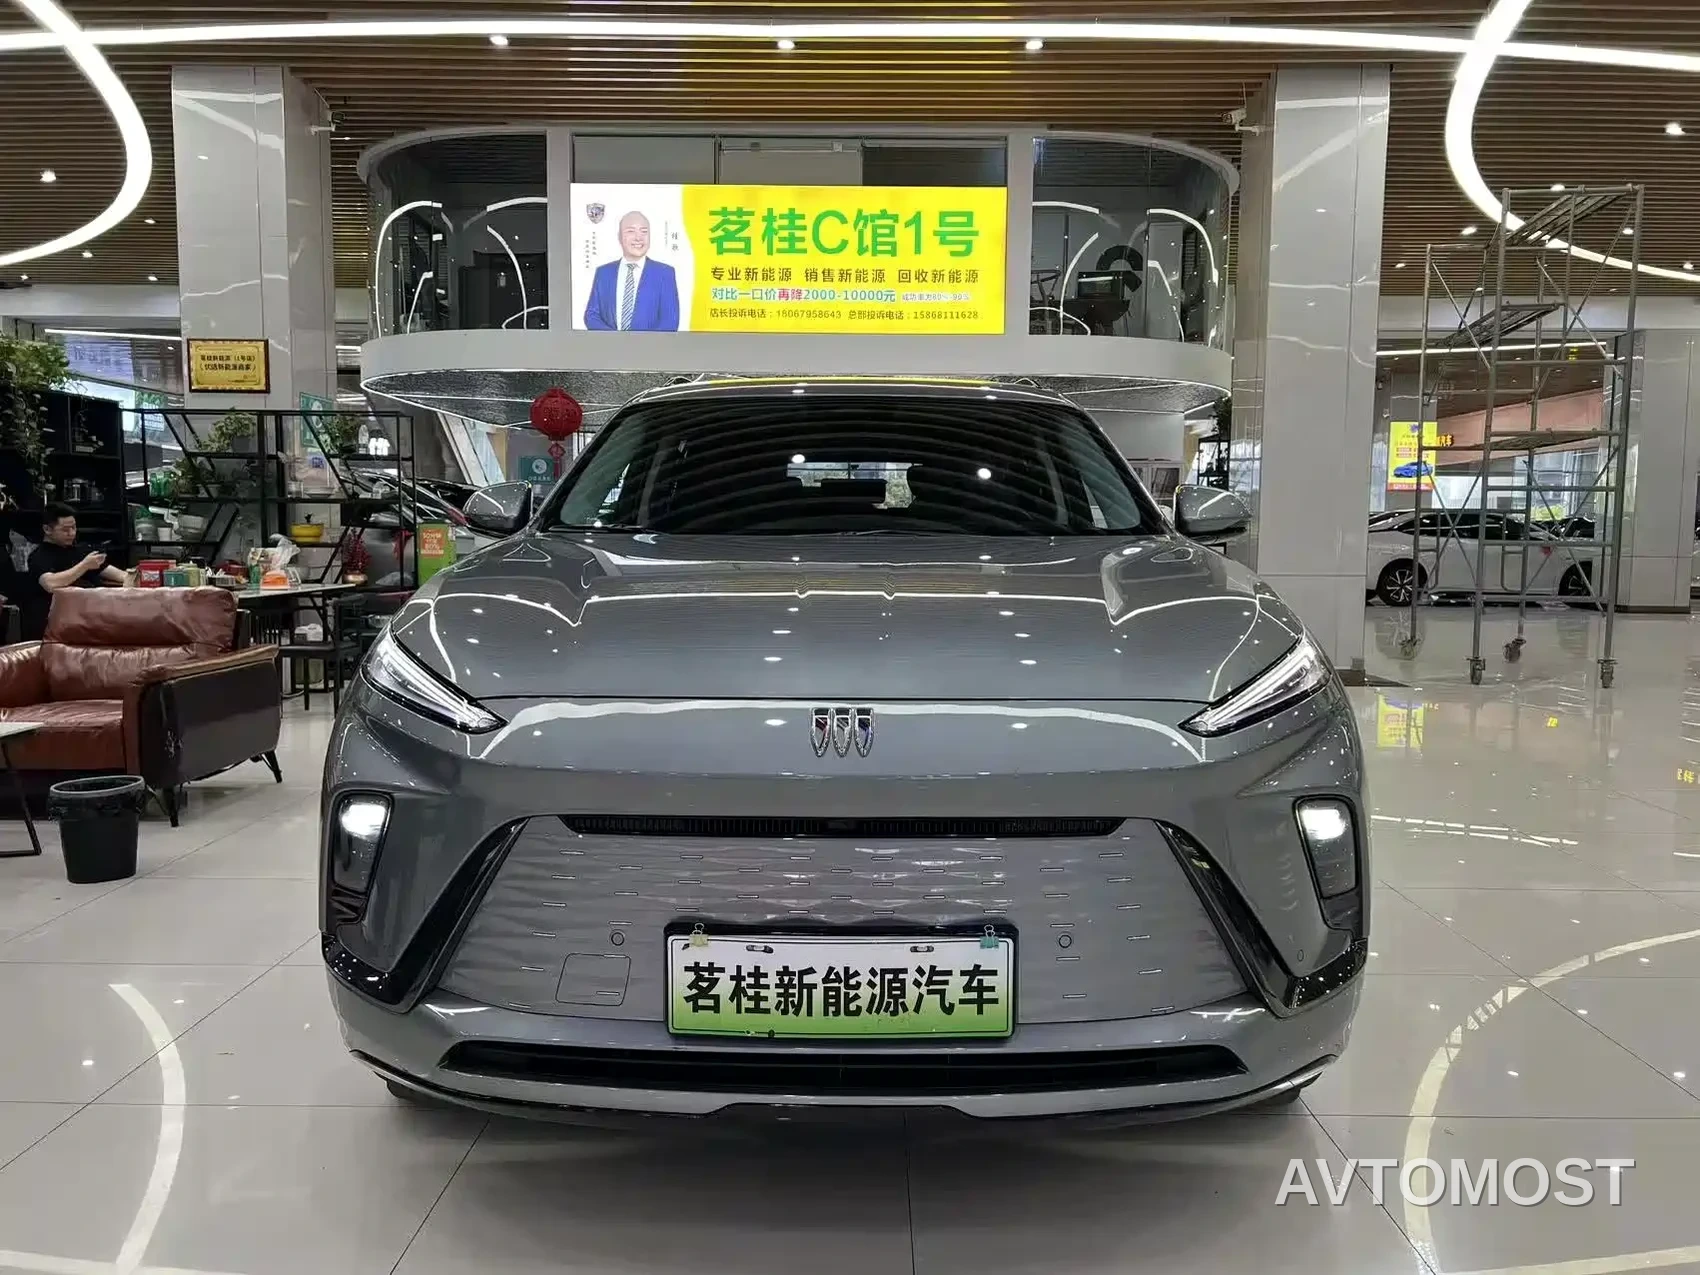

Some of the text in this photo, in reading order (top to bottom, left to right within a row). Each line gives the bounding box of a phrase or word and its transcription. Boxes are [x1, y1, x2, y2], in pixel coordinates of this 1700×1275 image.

[707, 206, 980, 258] 茗桂C馆1号
[711, 266, 979, 284] 专业新能源 销售新能源 回收新能源
[711, 287, 896, 303] 对比一口价再降2000-10000元
[683, 962, 1000, 1018] 茗桂新能源汽车
